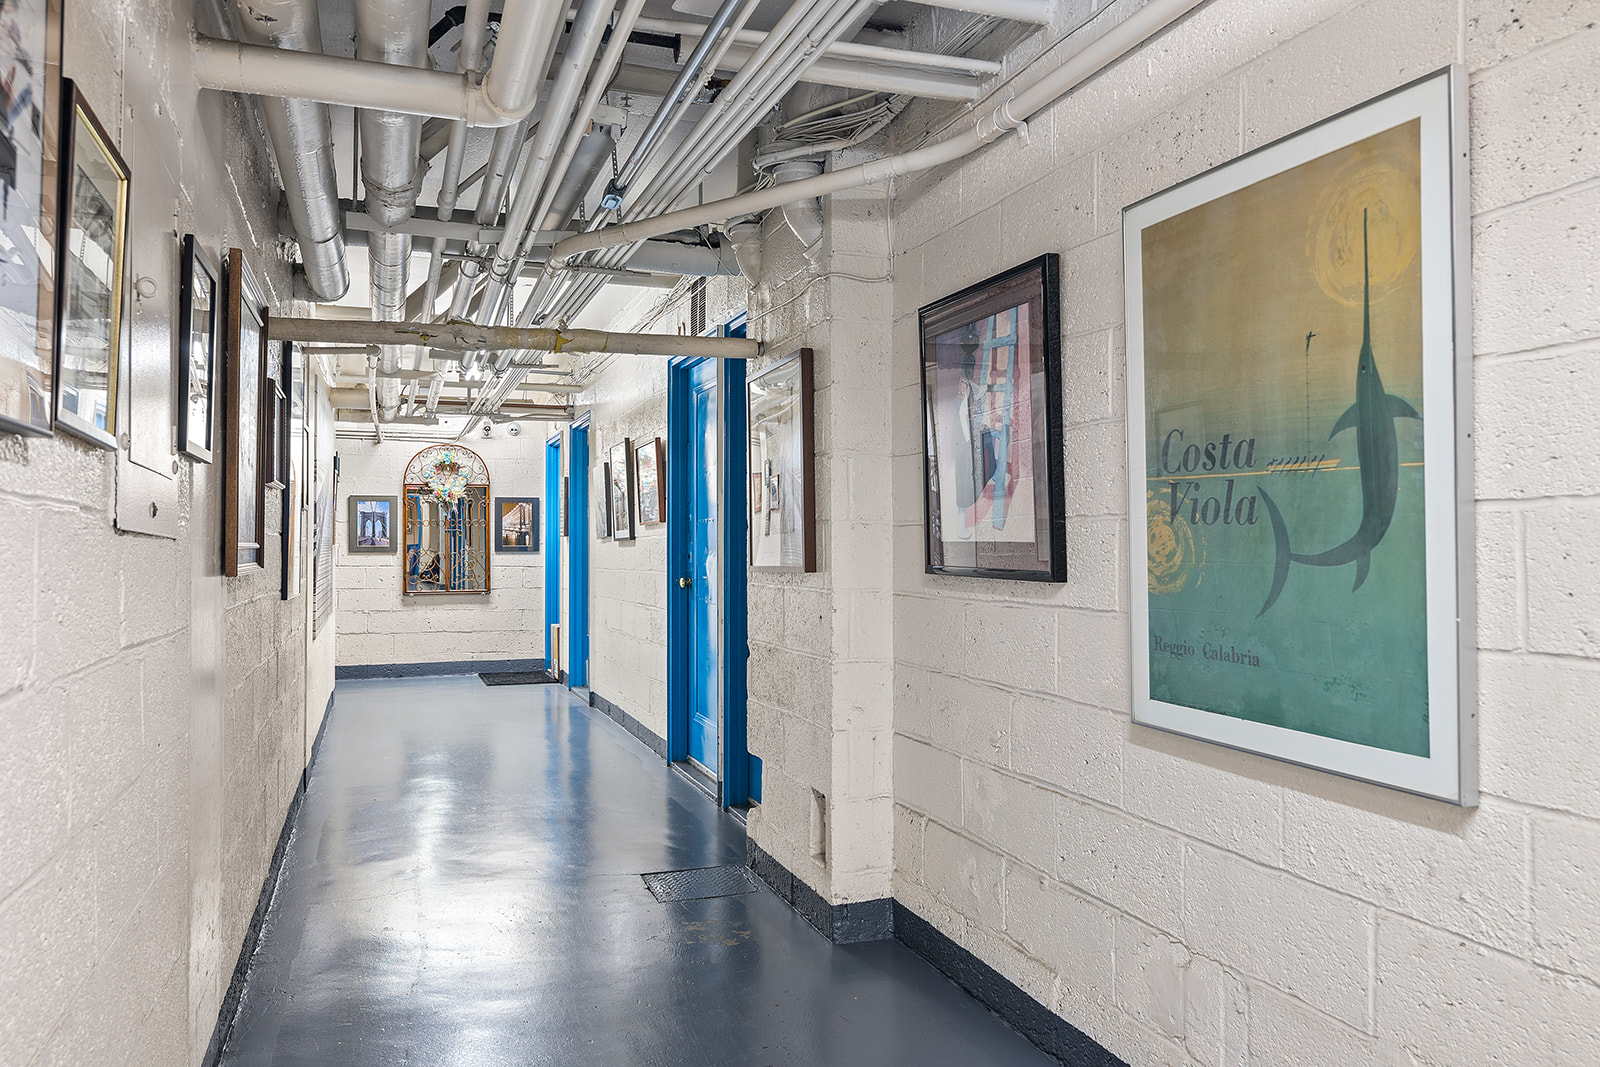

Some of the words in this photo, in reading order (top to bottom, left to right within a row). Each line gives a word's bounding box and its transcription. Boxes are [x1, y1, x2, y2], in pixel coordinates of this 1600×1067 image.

[1161, 429, 1257, 474] Costa
[1168, 479, 1259, 526] Viola
[1154, 635, 1195, 660] Reggio
[1202, 642, 1260, 667] Calabria
